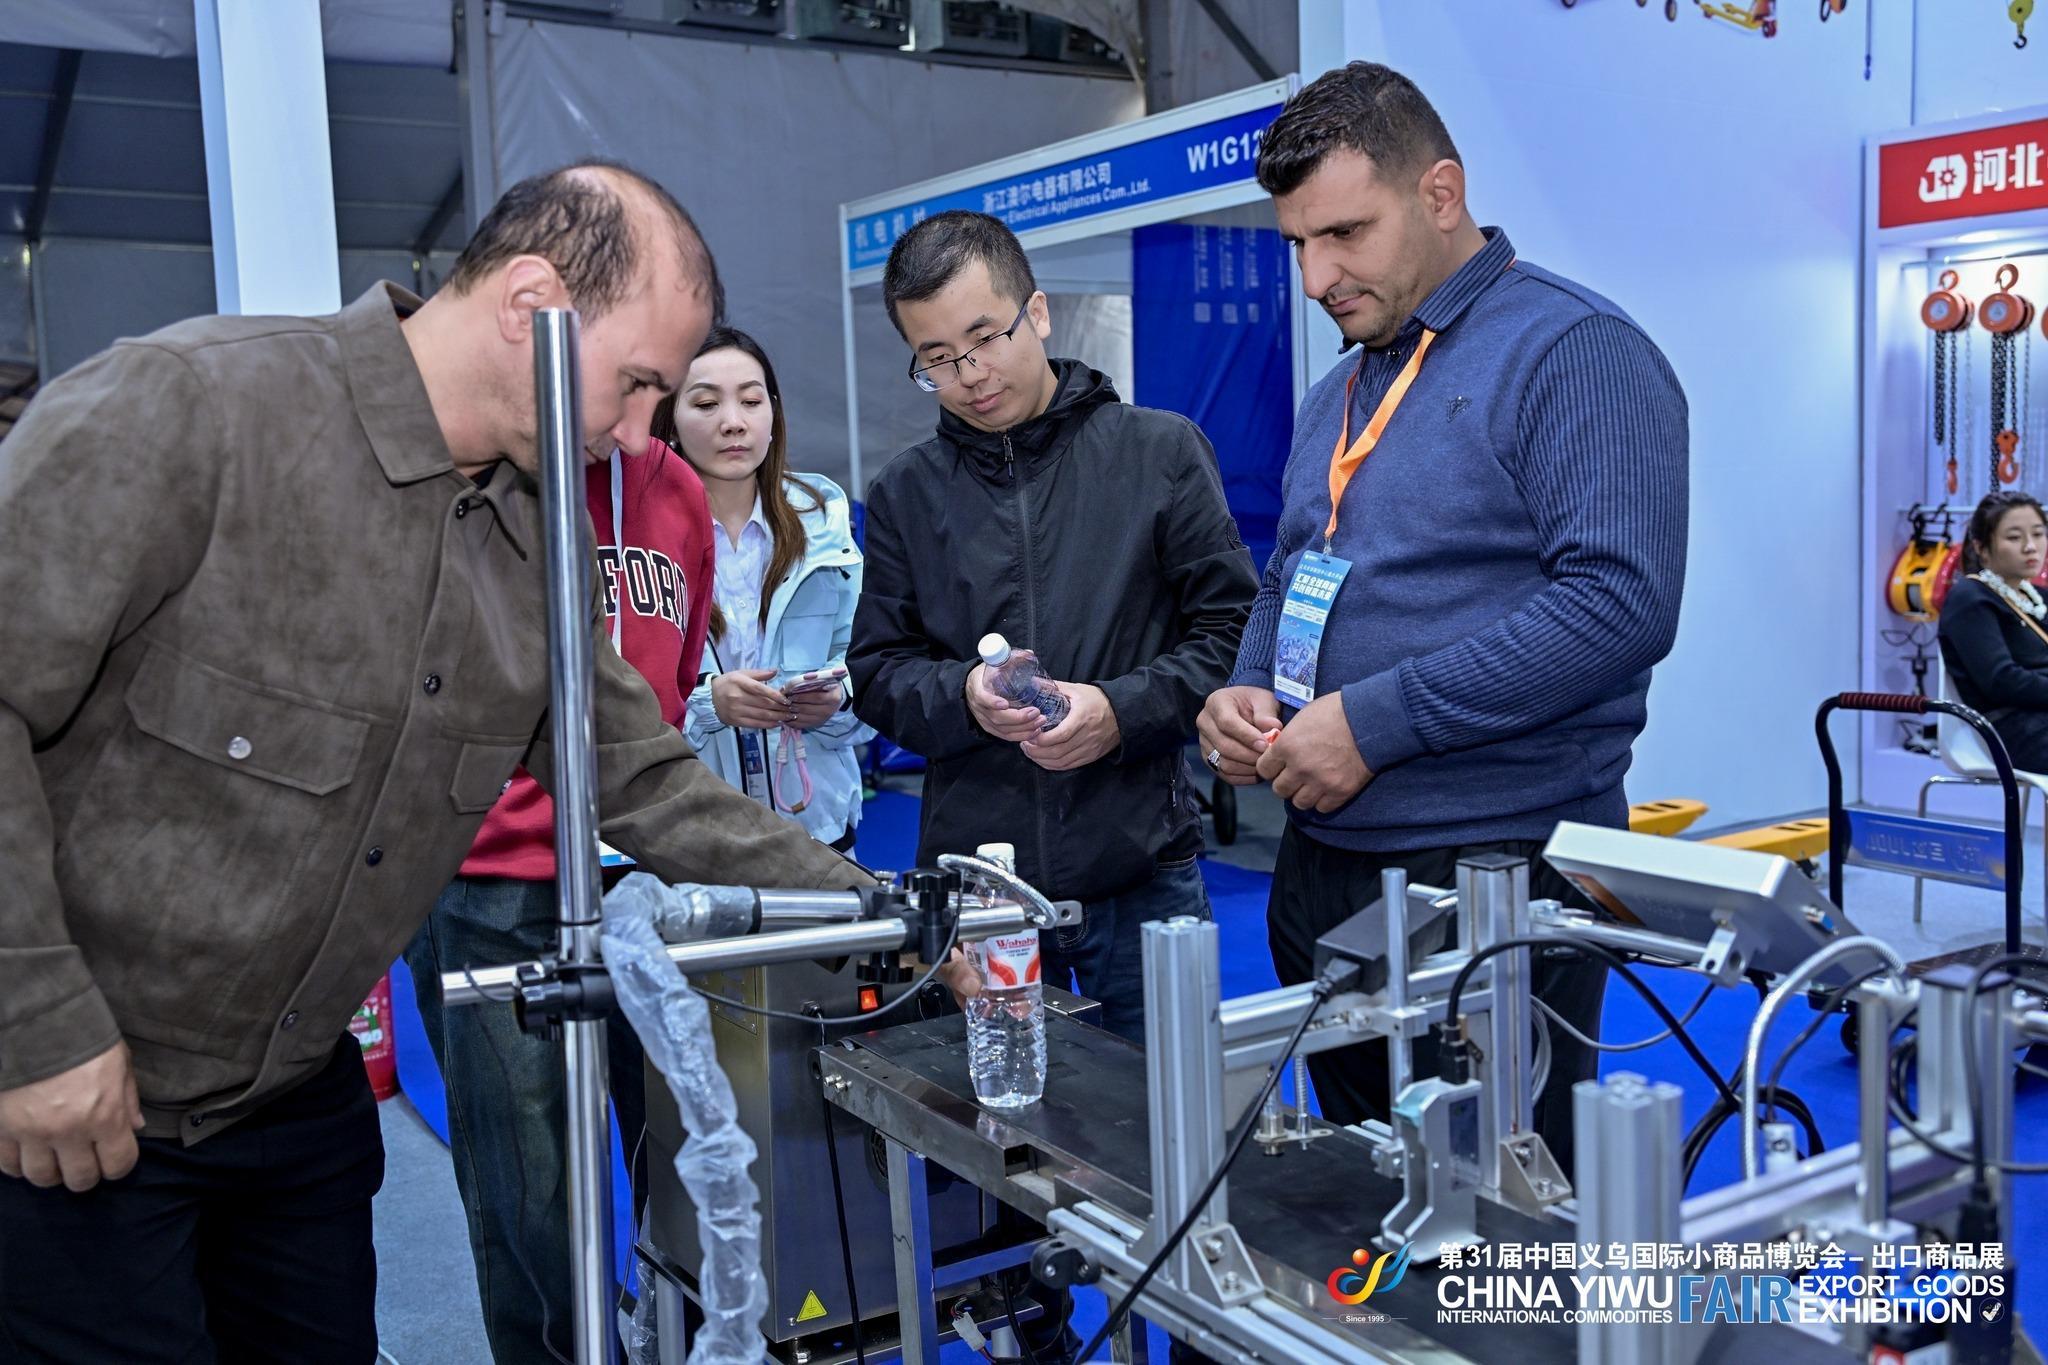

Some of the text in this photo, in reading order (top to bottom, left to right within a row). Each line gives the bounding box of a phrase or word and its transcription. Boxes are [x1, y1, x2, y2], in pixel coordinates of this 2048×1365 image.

[1973, 142, 2044, 194] 河北
[1009, 201, 1050, 224] Electrical
[1050, 193, 1102, 215] Appliances
